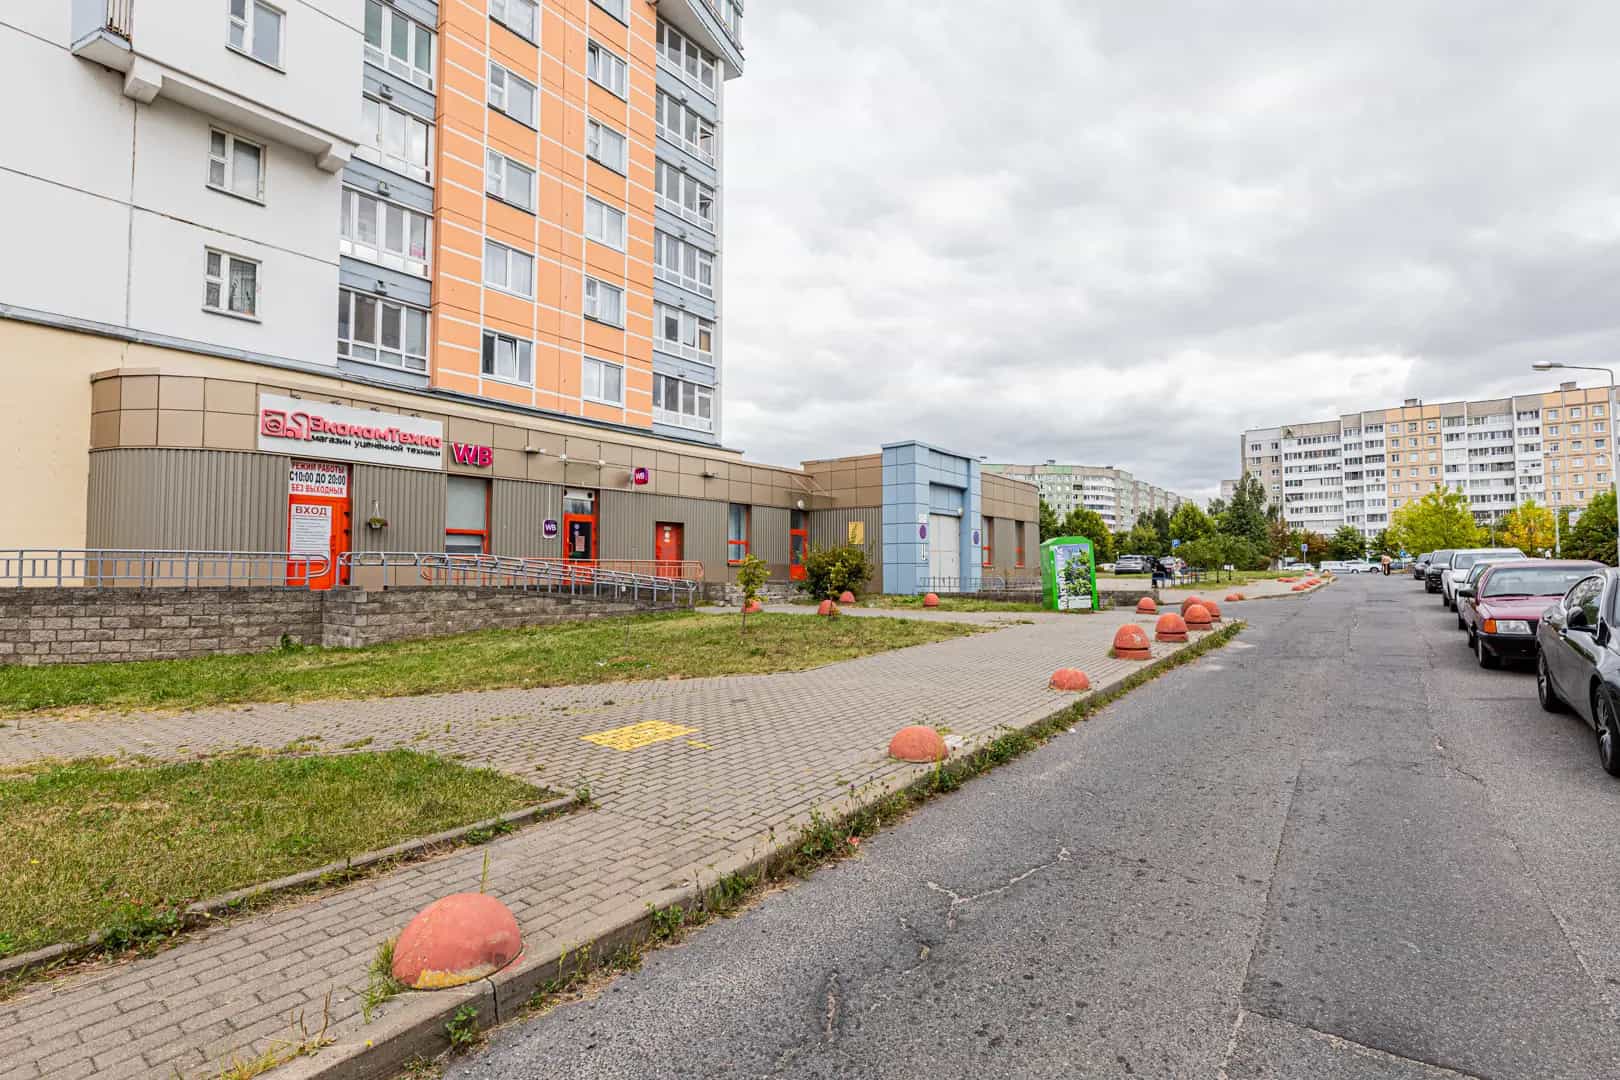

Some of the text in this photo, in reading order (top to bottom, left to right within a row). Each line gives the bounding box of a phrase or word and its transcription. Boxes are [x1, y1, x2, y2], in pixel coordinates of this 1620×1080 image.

[310, 415, 442, 449] ЭкономТехно
[311, 434, 351, 446] магазин
[405, 446, 441, 456] техники
[452, 442, 493, 467] WB
[317, 463, 345, 473] РАБОТЫ
[315, 473, 327, 483] ДО
[327, 474, 346, 486] 20:00
[291, 483, 344, 495] БЕЗ ВЫХОДНЫХ
[295, 506, 328, 516] ВХОД
[544, 523, 557, 531] WB
